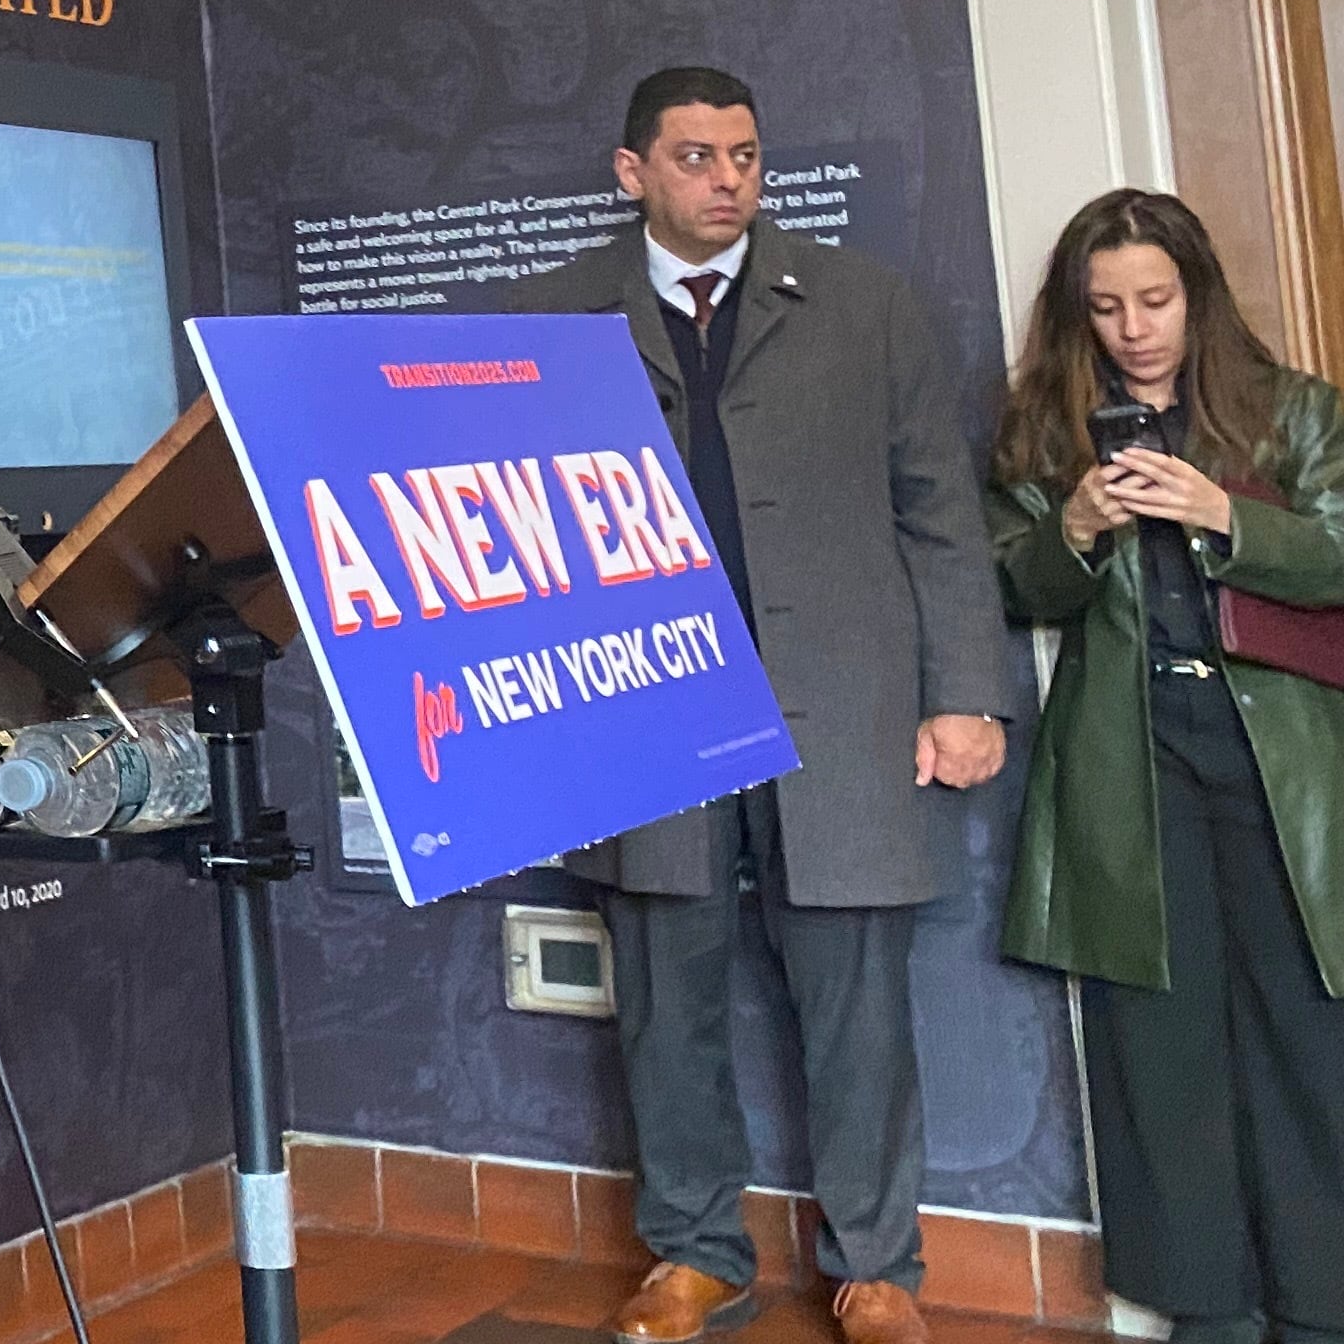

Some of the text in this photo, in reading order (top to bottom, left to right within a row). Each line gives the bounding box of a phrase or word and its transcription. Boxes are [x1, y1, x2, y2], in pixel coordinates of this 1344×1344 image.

[294, 219, 329, 234] Since
[330, 217, 347, 230] its
[411, 208, 435, 222] the
[436, 201, 488, 219] Central
[489, 198, 522, 214] Park
[522, 192, 615, 211] Conservancy
[764, 166, 822, 187] Central
[824, 163, 861, 181] Park
[295, 243, 304, 254] a
[305, 238, 334, 253] safe
[334, 235, 361, 250] and
[362, 229, 434, 247] welcoming
[434, 227, 473, 243] space
[475, 222, 496, 236] for
[520, 216, 547, 233] and
[786, 195, 804, 208] to
[805, 189, 846, 205] learn
[296, 259, 325, 274] how
[326, 259, 343, 272] to
[343, 254, 380, 269] make
[380, 251, 407, 266] this
[407, 248, 446, 263] vision
[447, 249, 459, 261] a
[505, 239, 537, 255] The
[299, 278, 366, 296] represents
[367, 277, 378, 289] a
[378, 274, 416, 287] move
[416, 266, 465, 284] toward
[465, 263, 519, 283] righting
[519, 264, 531, 275] a
[300, 298, 338, 314] battle
[339, 297, 359, 310] for
[360, 292, 399, 309] social
[303, 445, 711, 636] A NEW ERA
[413, 611, 727, 783] for NEW YORK CITY
[31, 878, 63, 903] 2020
